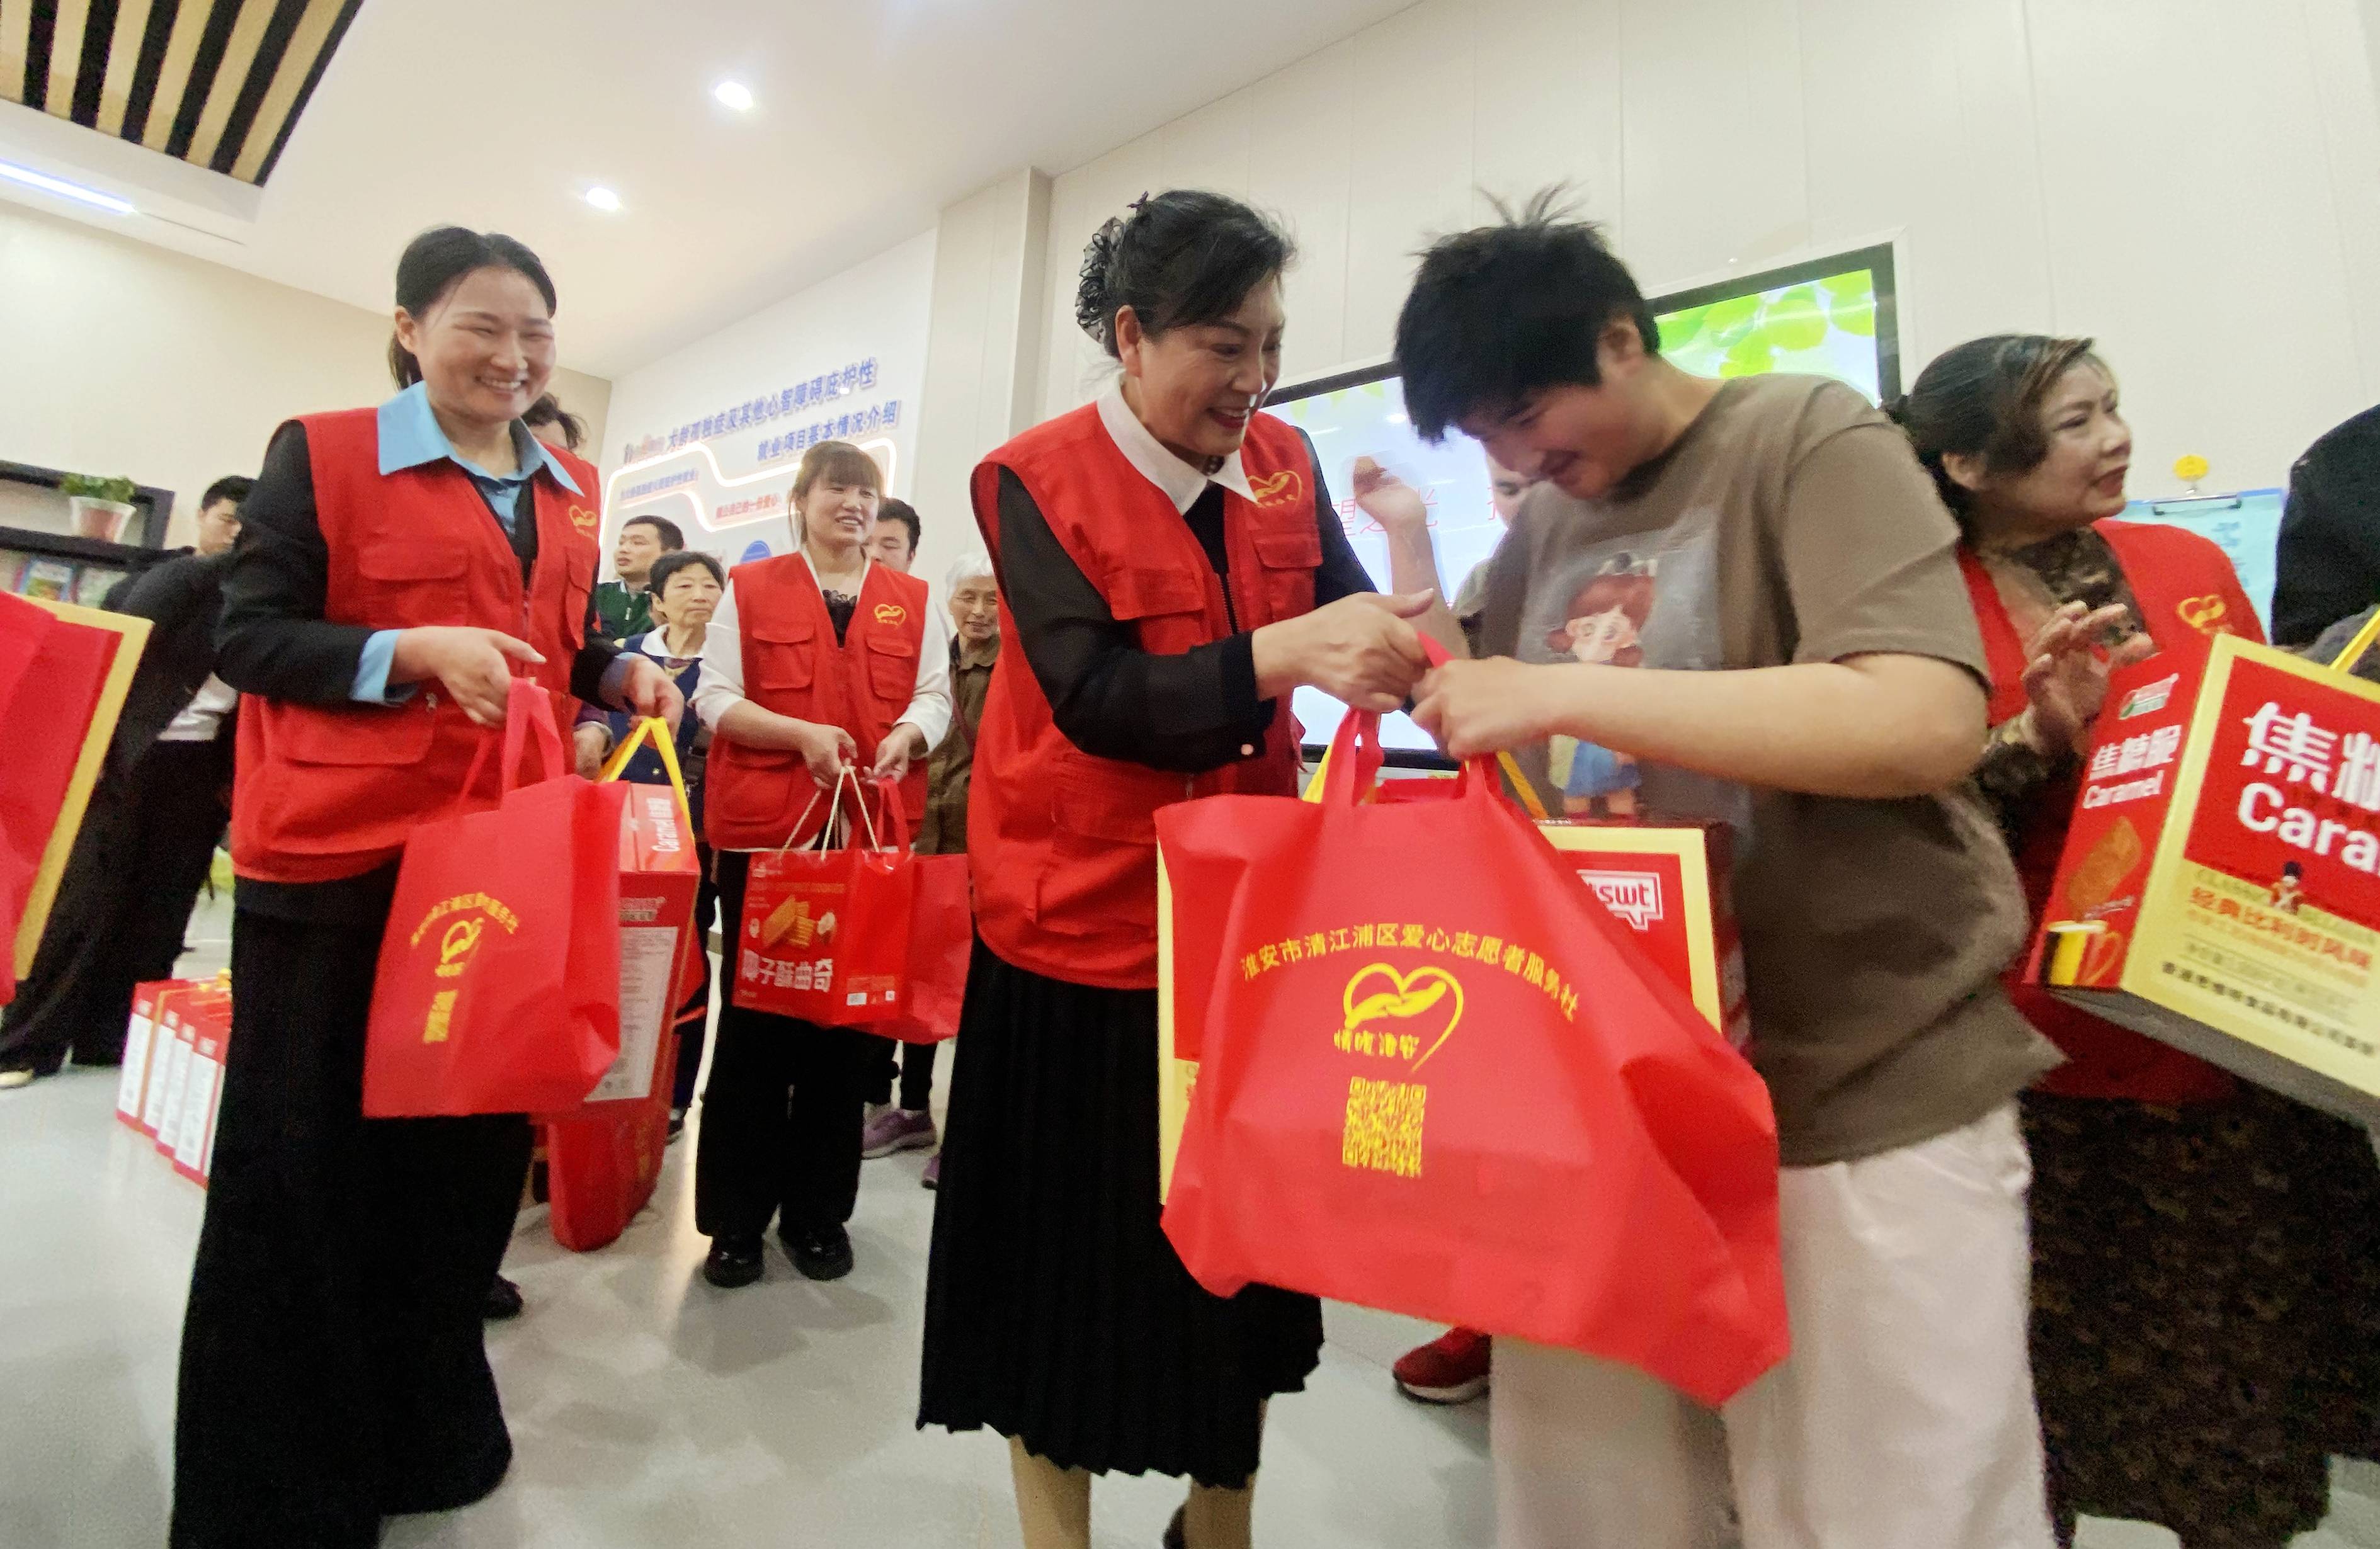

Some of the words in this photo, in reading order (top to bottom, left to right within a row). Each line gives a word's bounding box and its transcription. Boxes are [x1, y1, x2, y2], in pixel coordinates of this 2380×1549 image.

[758, 400, 897, 461] 就业项目基本情况介绍
[2237, 783, 2380, 875] Cara
[1240, 923, 1579, 1023] 淮安市清江浦区爱心志愿者服务社
